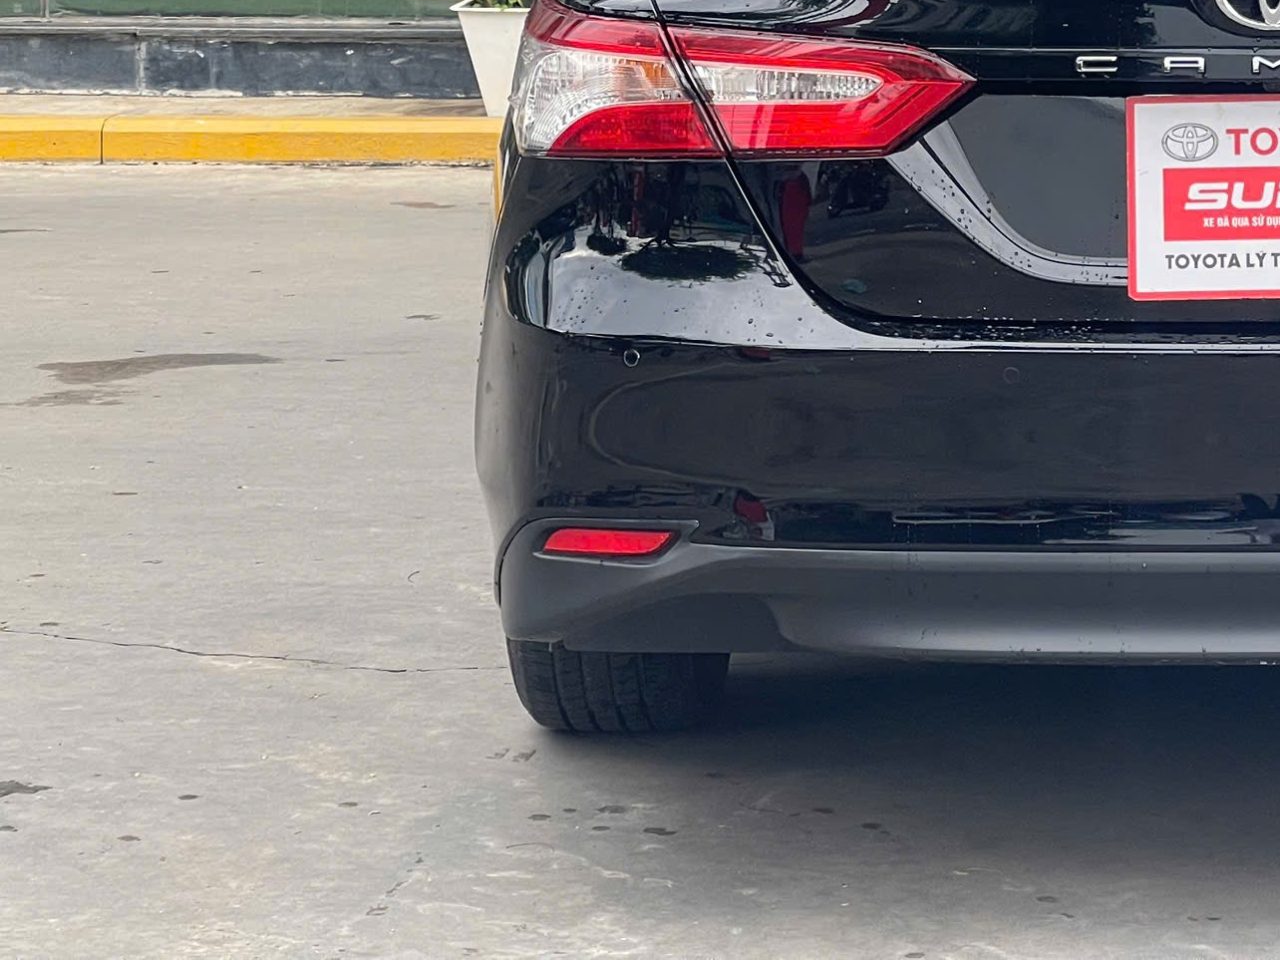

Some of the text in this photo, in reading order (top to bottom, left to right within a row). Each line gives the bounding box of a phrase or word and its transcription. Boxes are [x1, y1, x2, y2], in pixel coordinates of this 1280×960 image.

[1202, 216, 1215, 228] XE
[1231, 216, 1250, 228] QUA
[1165, 253, 1241, 269] TOYOTA
[1246, 250, 1267, 268] LÝ
